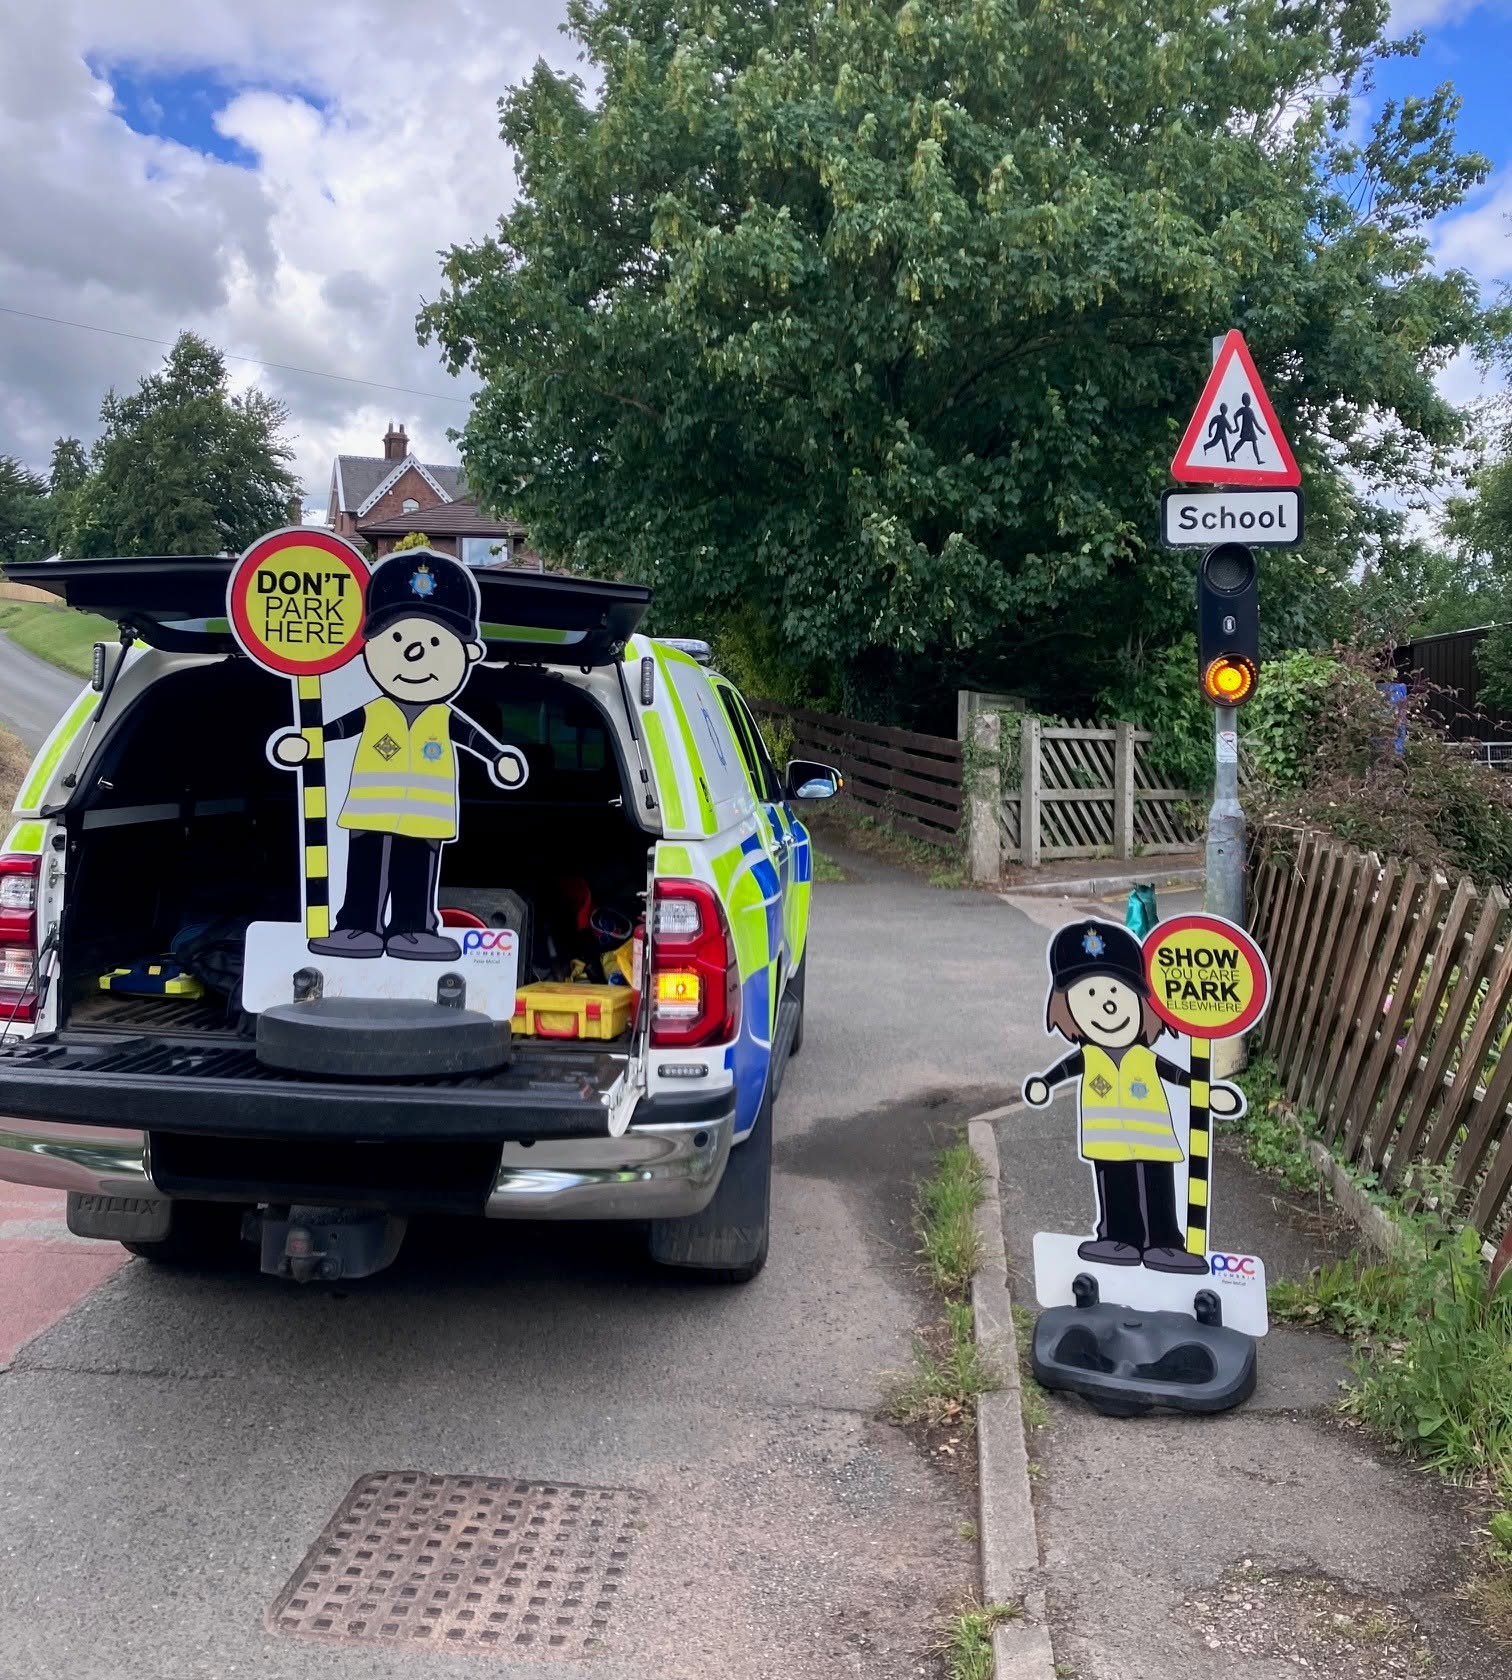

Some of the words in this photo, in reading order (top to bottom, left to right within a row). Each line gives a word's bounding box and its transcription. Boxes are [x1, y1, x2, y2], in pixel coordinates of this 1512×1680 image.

[1178, 504, 1287, 530] School
[257, 570, 350, 597] DON'T
[265, 596, 344, 621] PARK
[265, 620, 345, 645] HERE
[1158, 947, 1239, 969] SHOW
[1161, 967, 1193, 980] YOU
[1198, 969, 1240, 982] CARE
[1165, 980, 1242, 1003] PARK
[1166, 1000, 1243, 1012] ELSEWHERE
